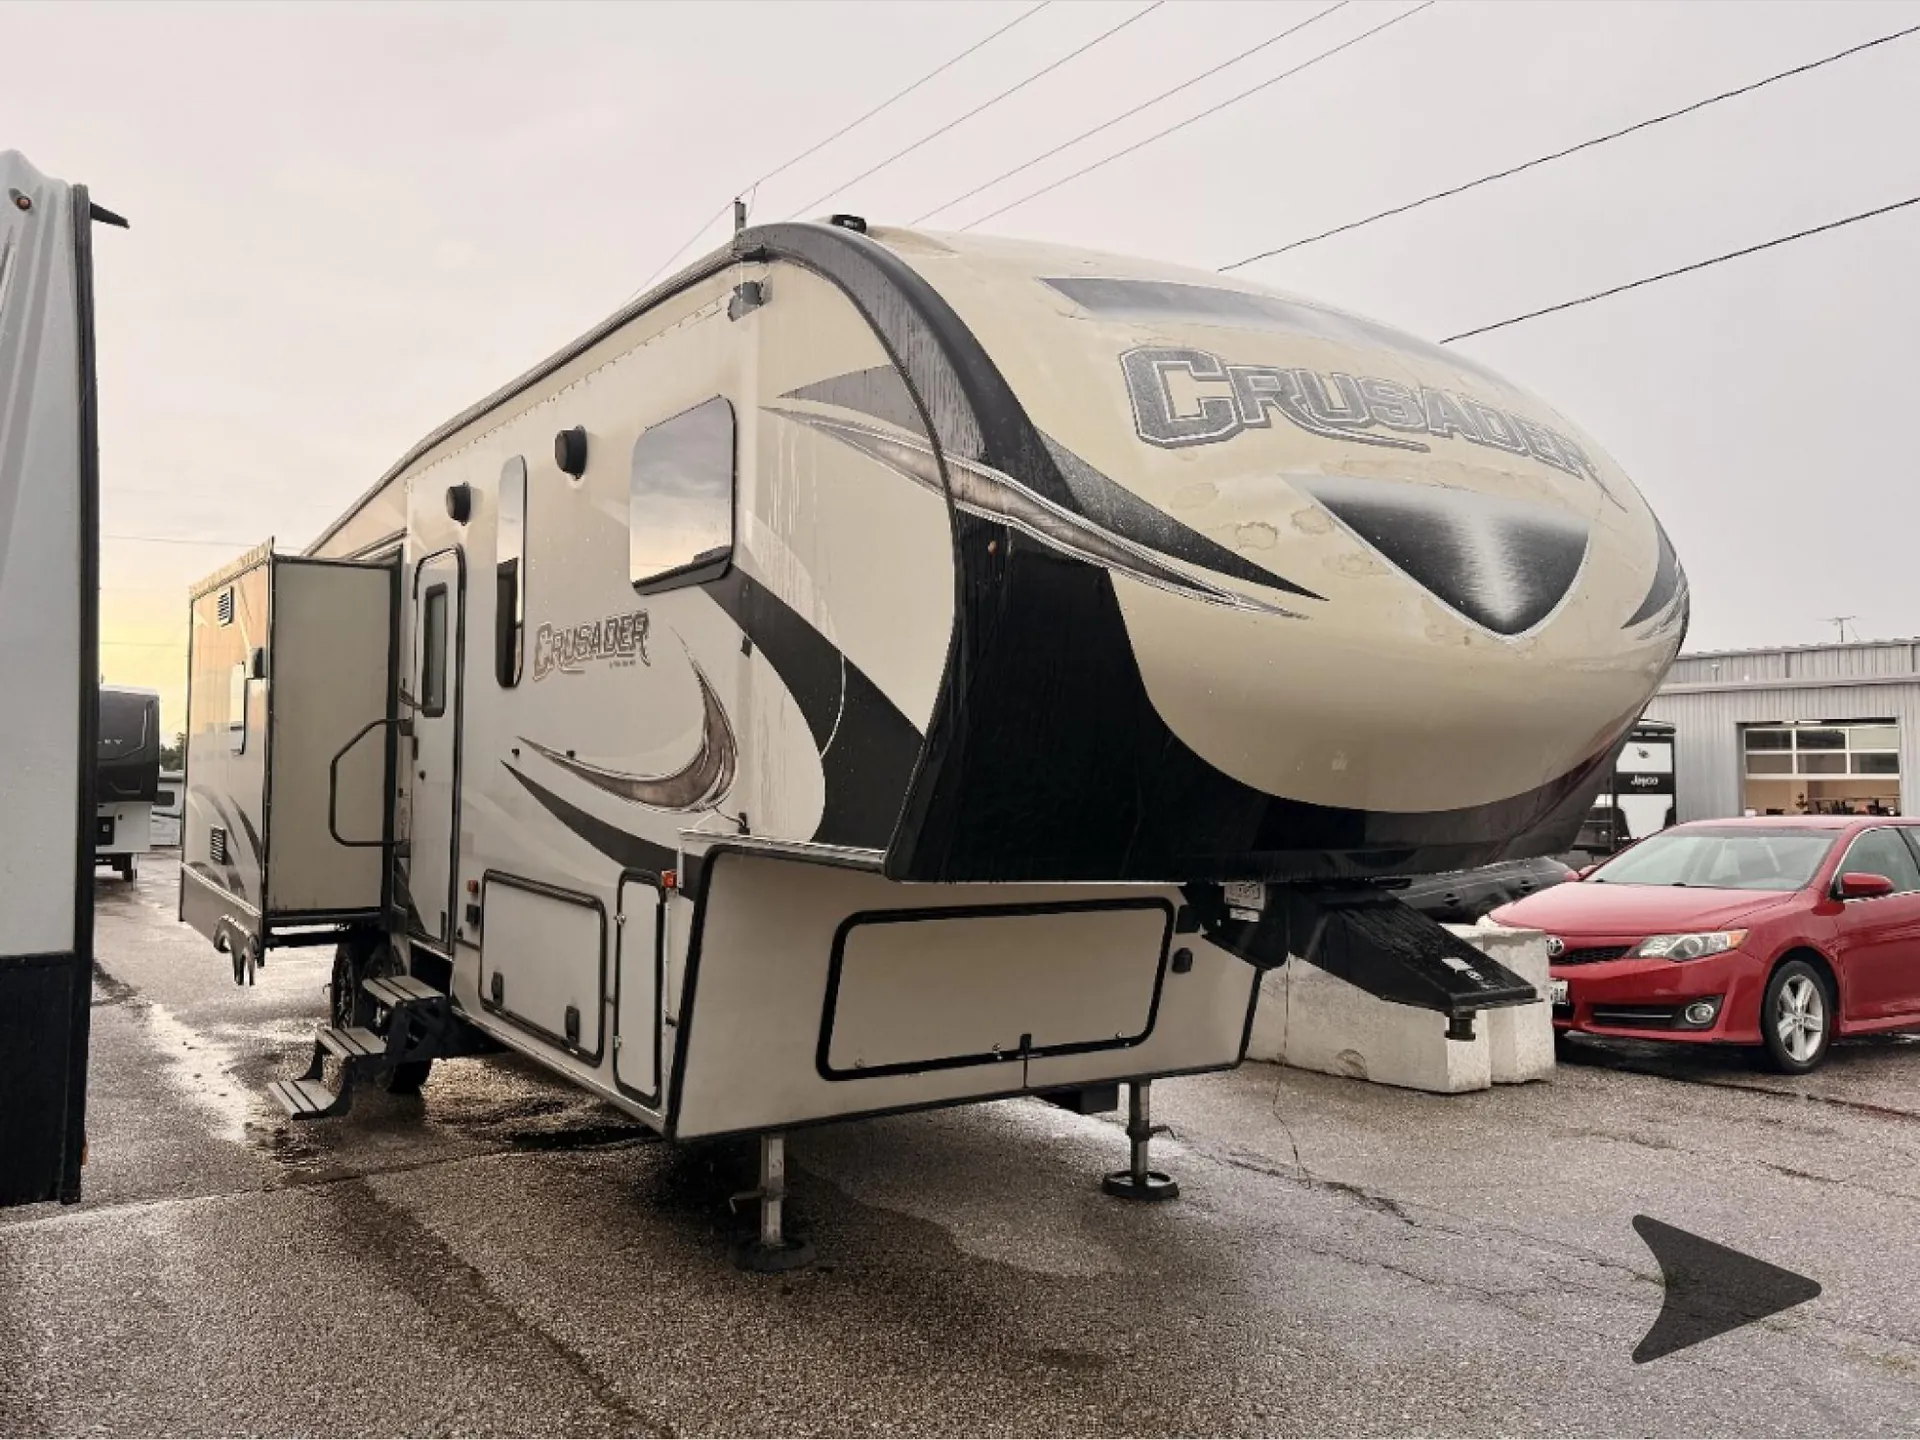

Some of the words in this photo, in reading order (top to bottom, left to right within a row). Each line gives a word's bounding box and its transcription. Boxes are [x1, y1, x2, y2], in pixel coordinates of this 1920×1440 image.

[1119, 345, 1600, 488] CRUSADER
[533, 609, 650, 681] CRUSADER
[1631, 774, 1658, 787] Jayco
